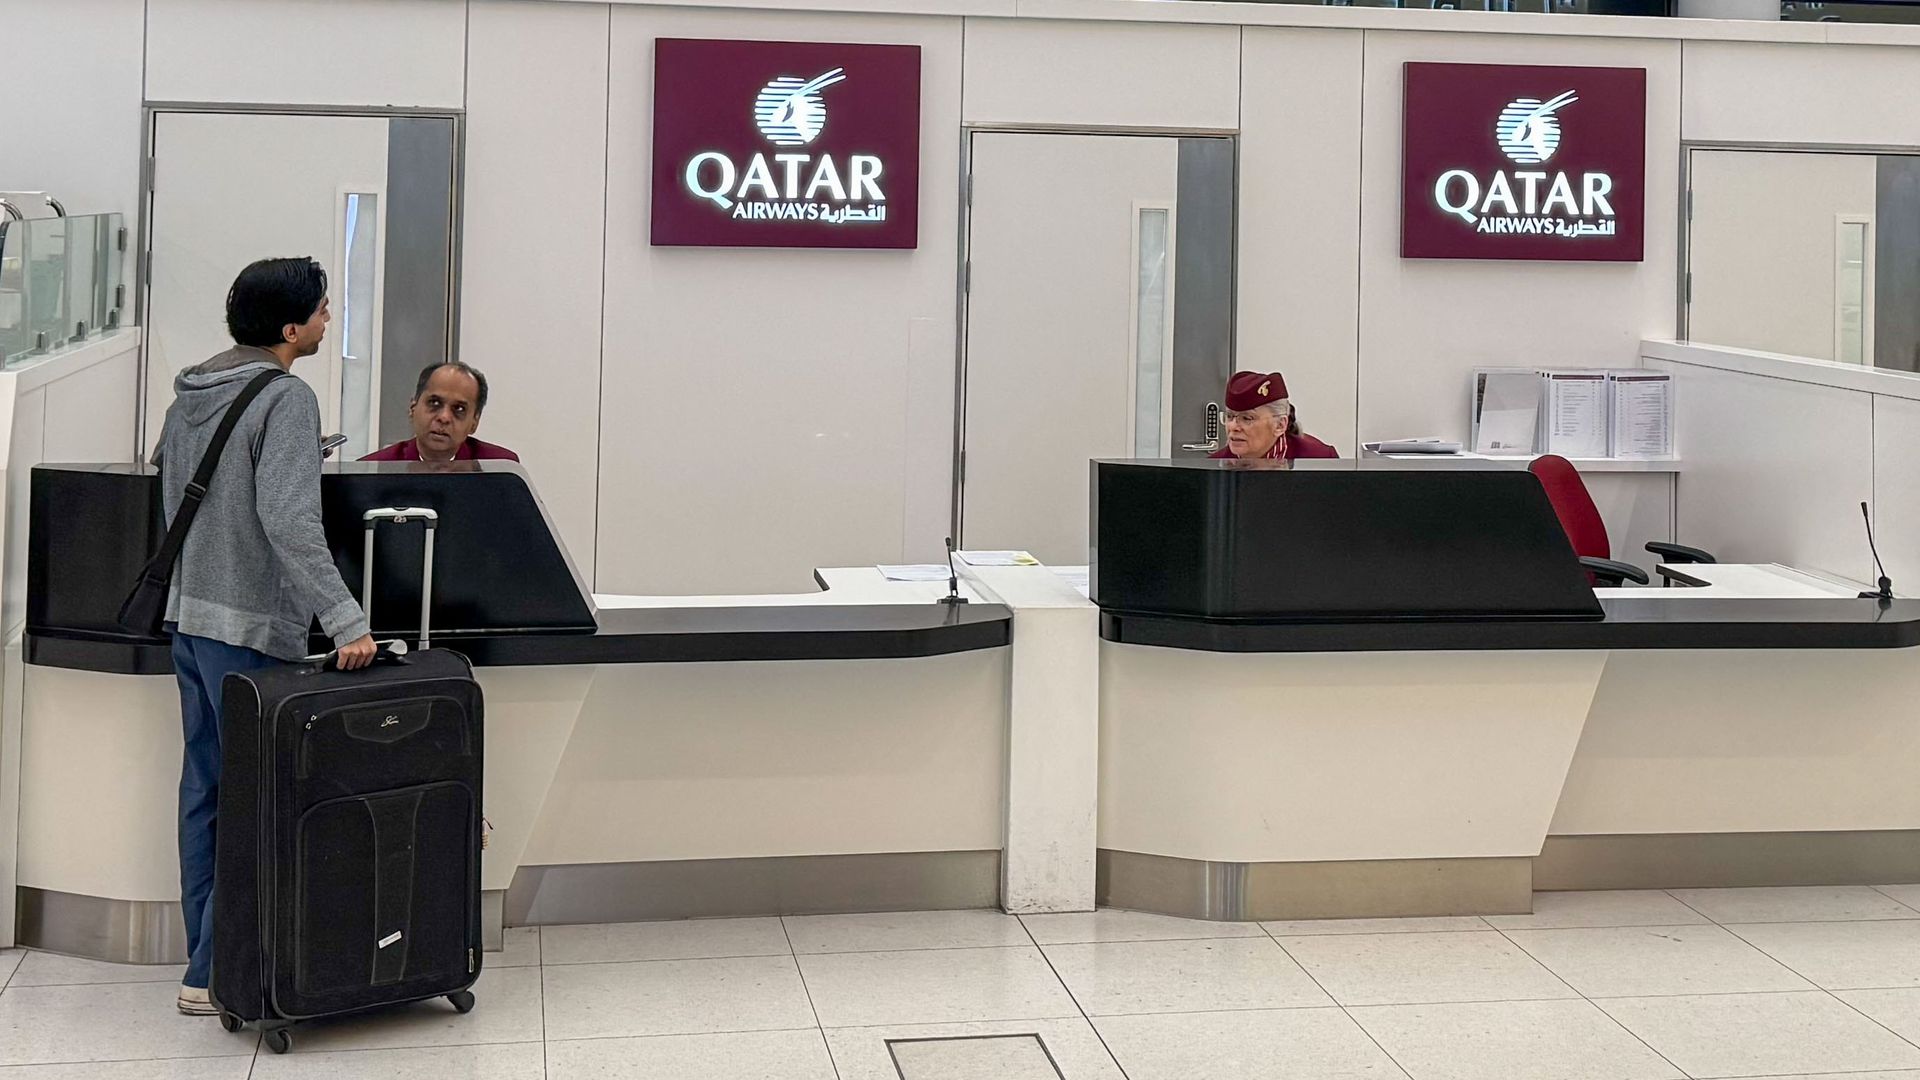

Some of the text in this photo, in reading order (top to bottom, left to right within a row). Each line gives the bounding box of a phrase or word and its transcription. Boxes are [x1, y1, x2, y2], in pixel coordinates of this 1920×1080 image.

[685, 151, 886, 209] QATAR
[1434, 169, 1615, 224] QATAR
[732, 201, 819, 220] AIRWAYS
[819, 203, 886, 224] القطرية
[1476, 216, 1555, 234] AIRWAYS
[1555, 218, 1616, 238] القطرية
